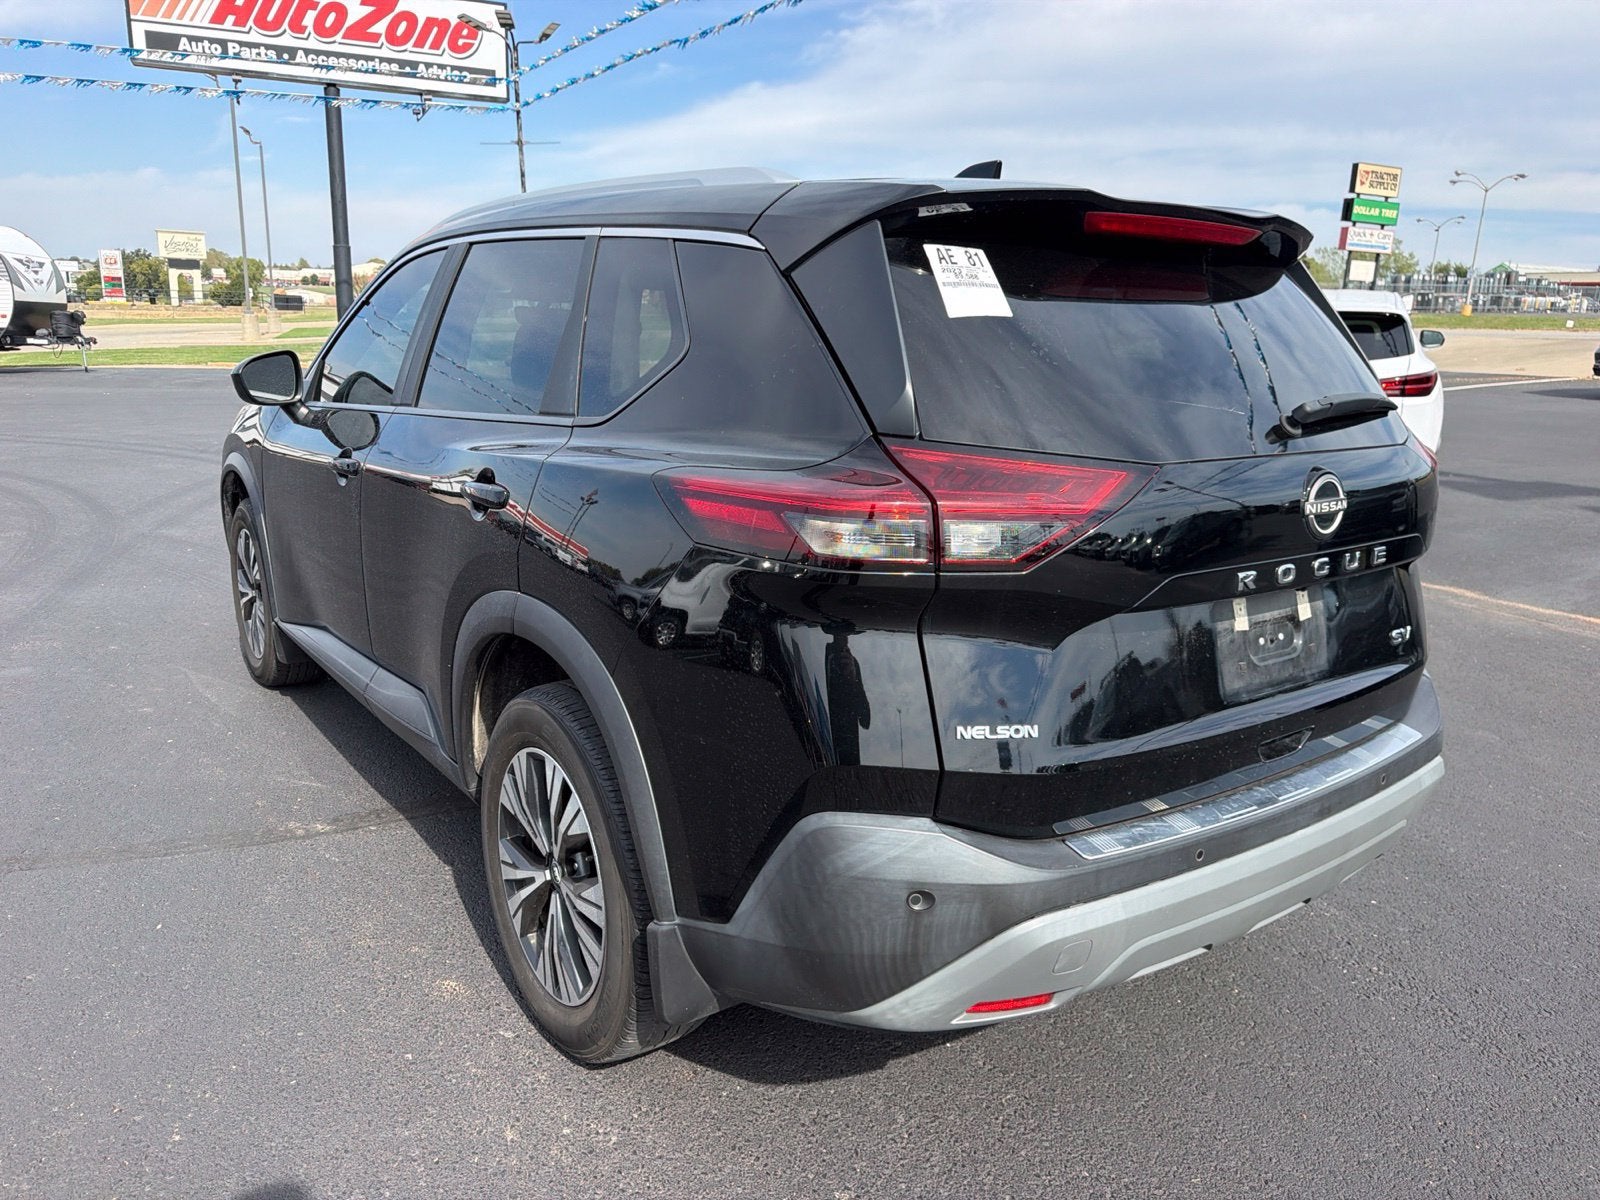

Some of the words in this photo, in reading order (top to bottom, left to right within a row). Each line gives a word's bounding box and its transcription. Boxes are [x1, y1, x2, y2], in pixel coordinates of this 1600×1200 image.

[177, 36, 222, 56] Auto
[227, 41, 277, 60] Parts
[294, 49, 400, 74] Accessories
[1371, 170, 1398, 182] TRACTOR
[1353, 205, 1380, 216] DOLLAR
[1381, 208, 1397, 218] TREE
[936, 247, 958, 265] AE
[964, 250, 984, 268] 81
[1305, 497, 1347, 515] NISSAN
[1237, 545, 1388, 592] ROGUE
[956, 724, 1039, 740] NELSON
